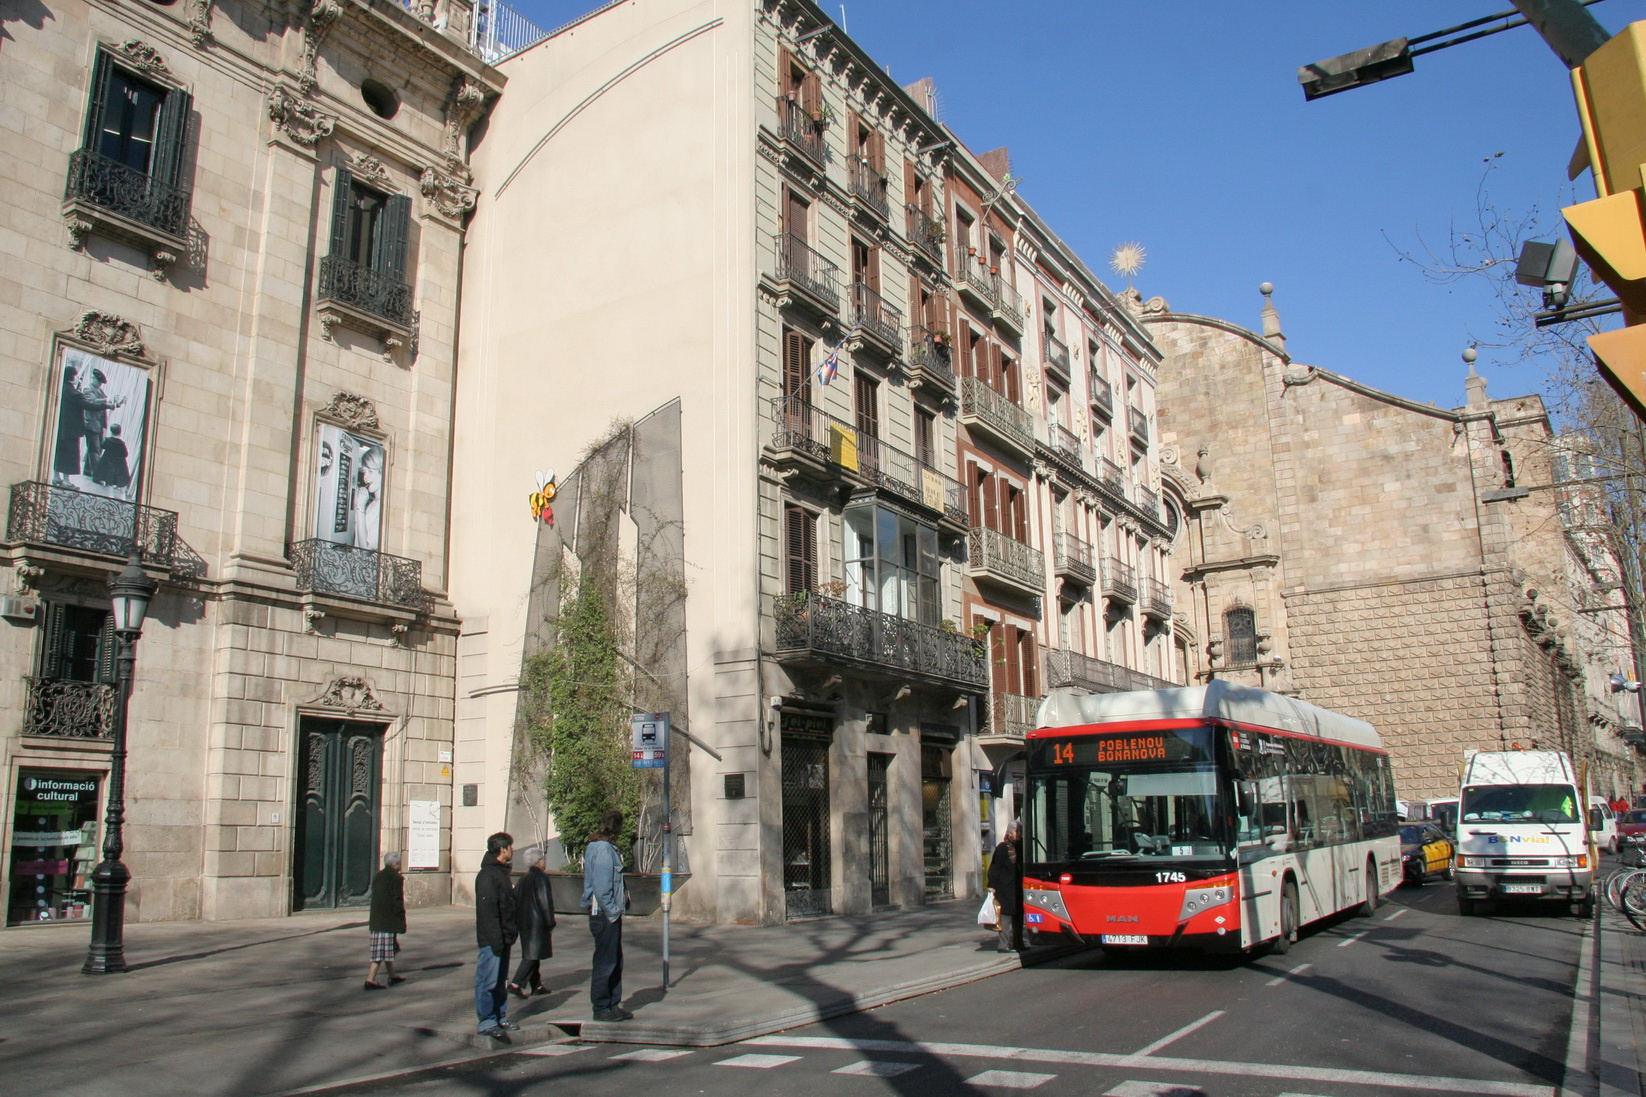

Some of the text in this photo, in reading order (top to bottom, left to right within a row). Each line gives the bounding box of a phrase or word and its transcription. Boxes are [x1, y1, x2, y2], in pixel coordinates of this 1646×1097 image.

[1099, 736, 1163, 751] POBLENOU
[1053, 742, 1074, 764] 14
[1098, 747, 1166, 762] BONANOVA
[38, 779, 95, 791] informació
[37, 791, 78, 801] cultural
[1488, 836, 1551, 844] BCNvia!
[1155, 872, 1187, 883] 1745
[1107, 934, 1146, 943] 4713 FJK
